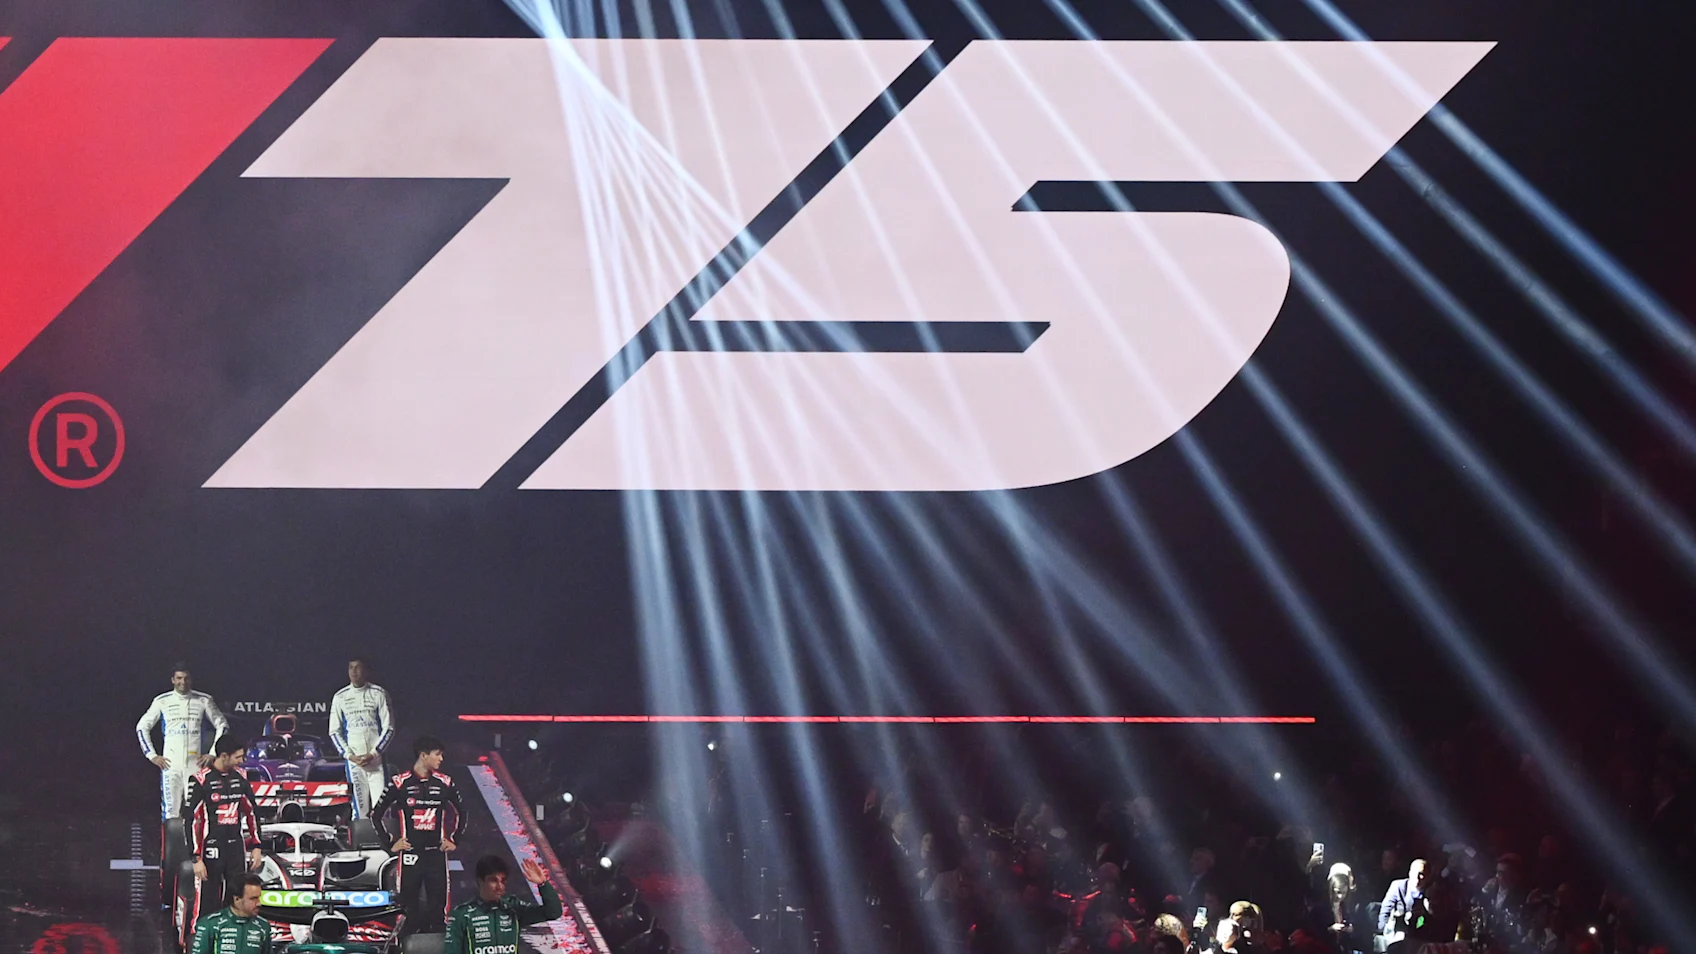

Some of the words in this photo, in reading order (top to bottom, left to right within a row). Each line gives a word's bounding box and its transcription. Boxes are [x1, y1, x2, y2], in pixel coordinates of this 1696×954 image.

[205, 847, 219, 859] 31
[403, 854, 419, 865] 87
[474, 944, 516, 954] aramco
